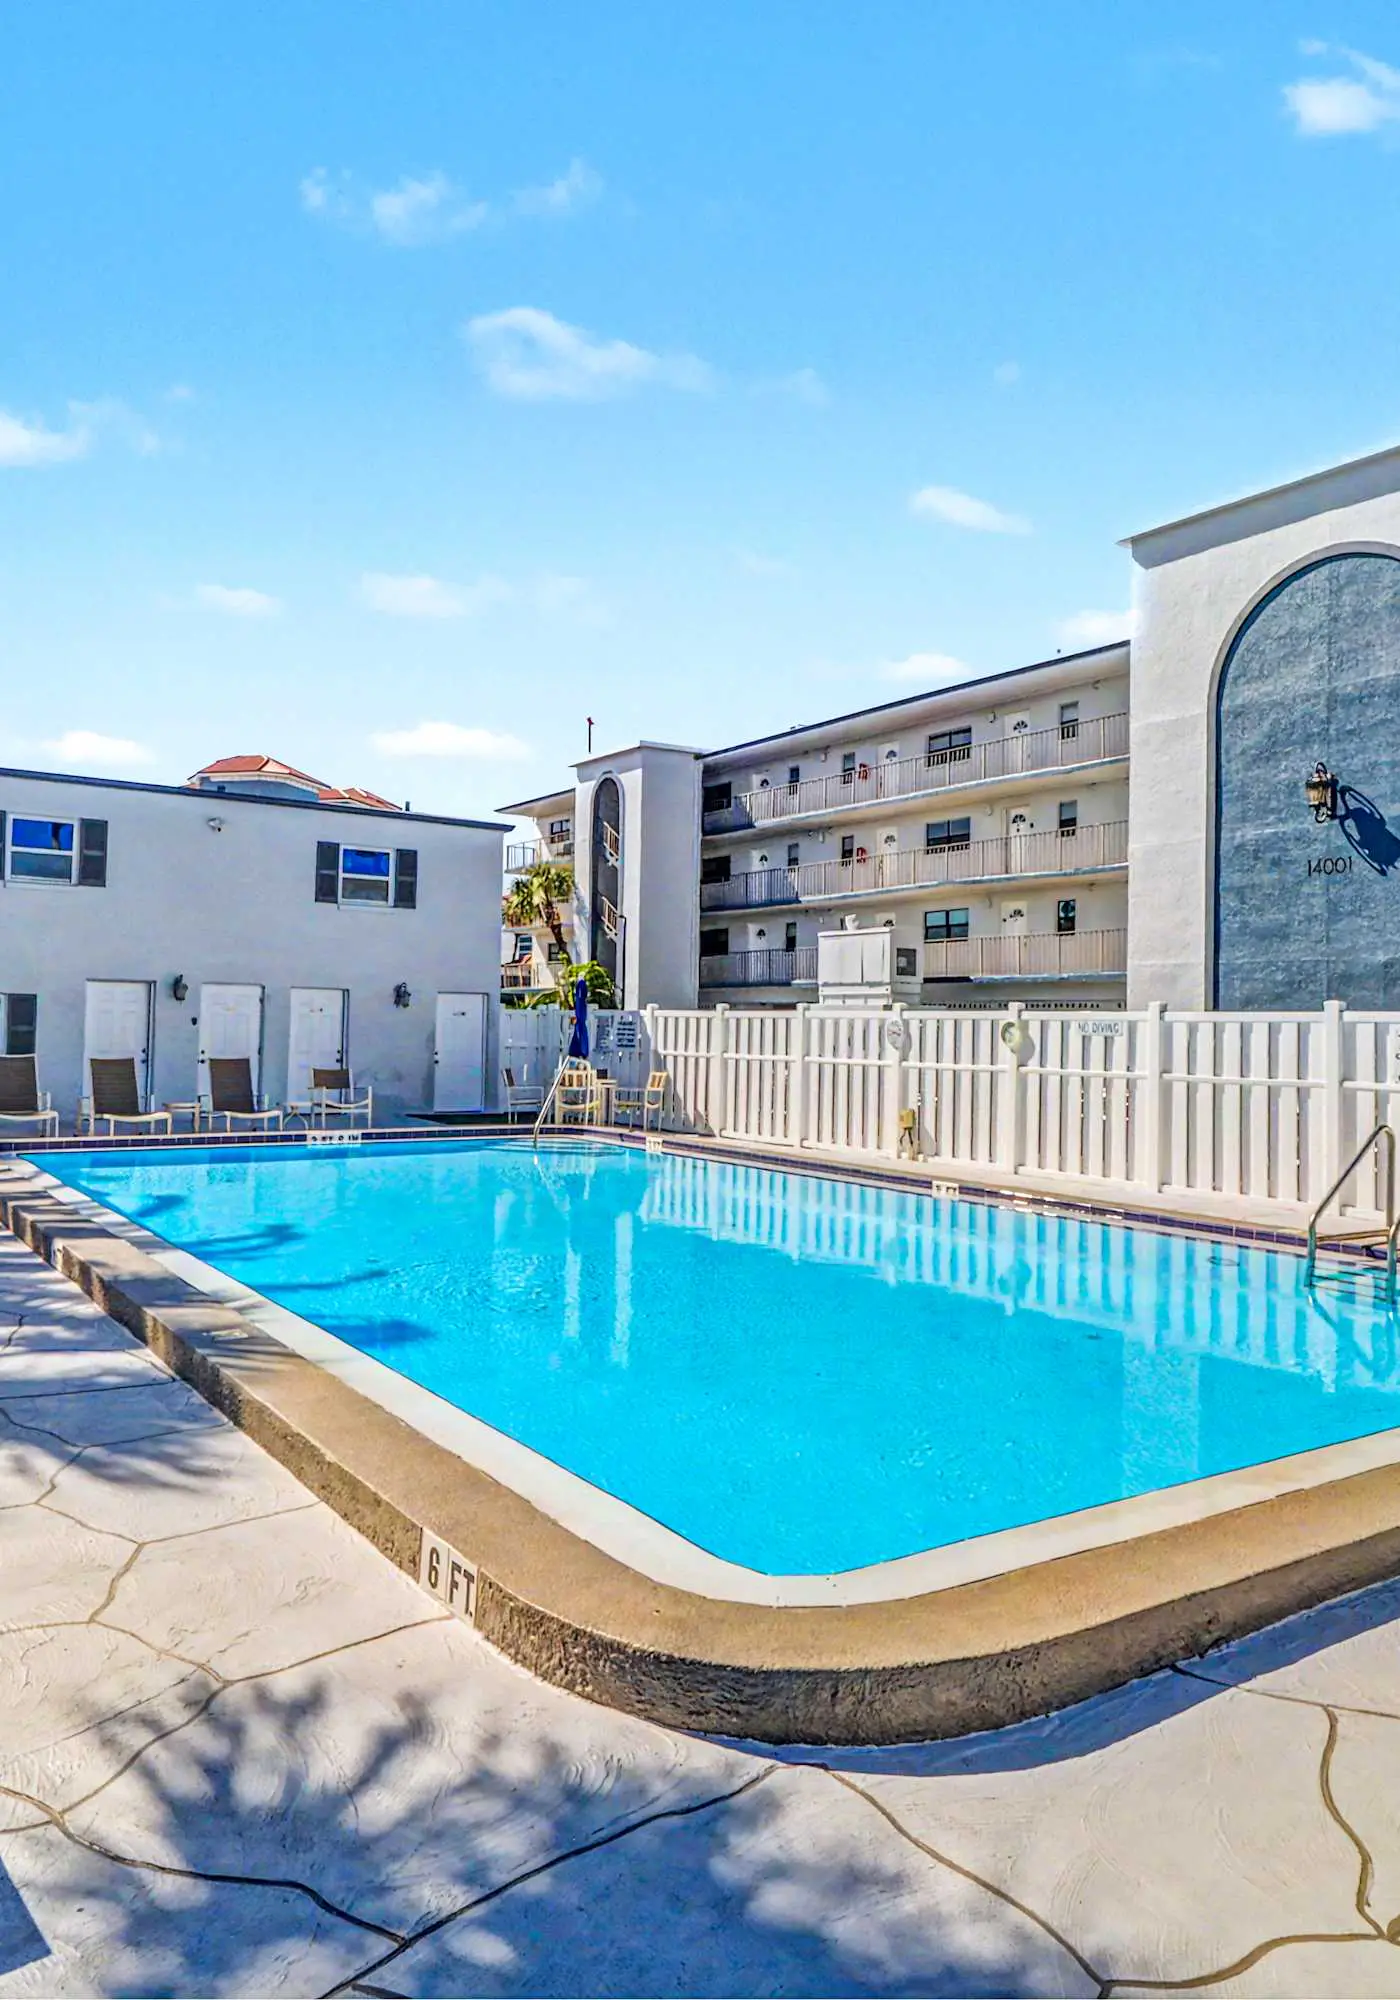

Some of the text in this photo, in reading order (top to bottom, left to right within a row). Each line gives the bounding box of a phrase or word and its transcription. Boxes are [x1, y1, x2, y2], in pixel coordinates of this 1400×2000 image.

[1307, 856, 1352, 877] 14001
[1078, 1022, 1119, 1034] NO DIVING
[428, 1546, 440, 1589] 6
